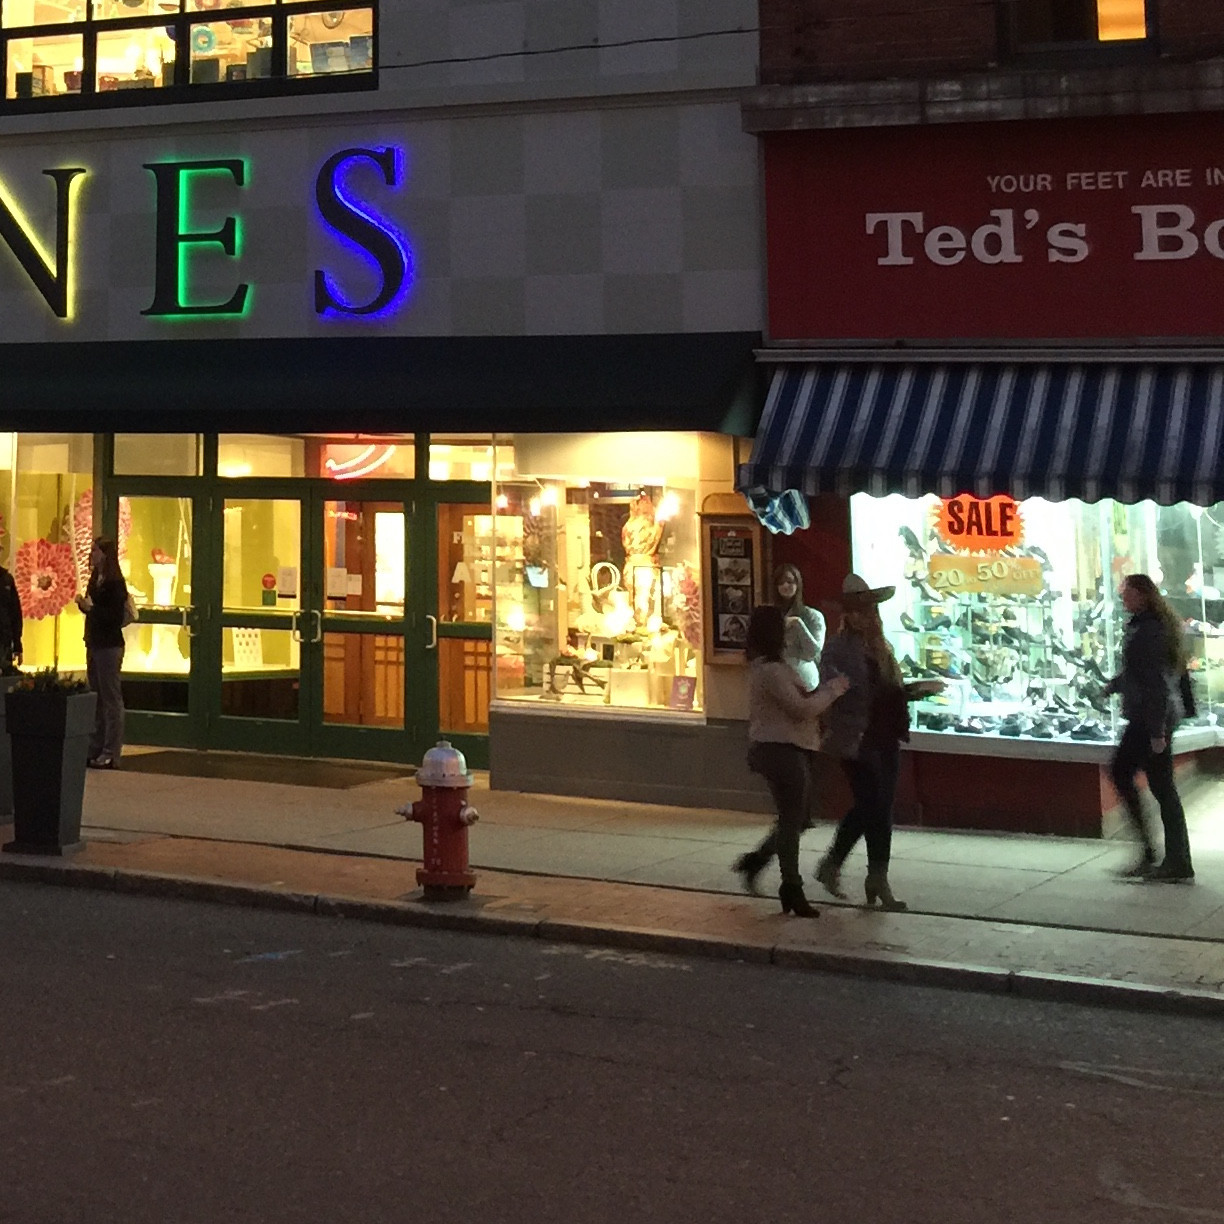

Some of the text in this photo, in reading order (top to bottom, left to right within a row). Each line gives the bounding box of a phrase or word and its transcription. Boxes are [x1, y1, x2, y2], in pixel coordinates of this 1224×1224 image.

[987, 174, 1052, 193] YOUR
[1067, 171, 1128, 190] FEET
[1141, 169, 1192, 188] ARE
[866, 209, 1089, 265] Ted's
[947, 499, 1014, 537] SALE
[932, 568, 962, 588] 20
